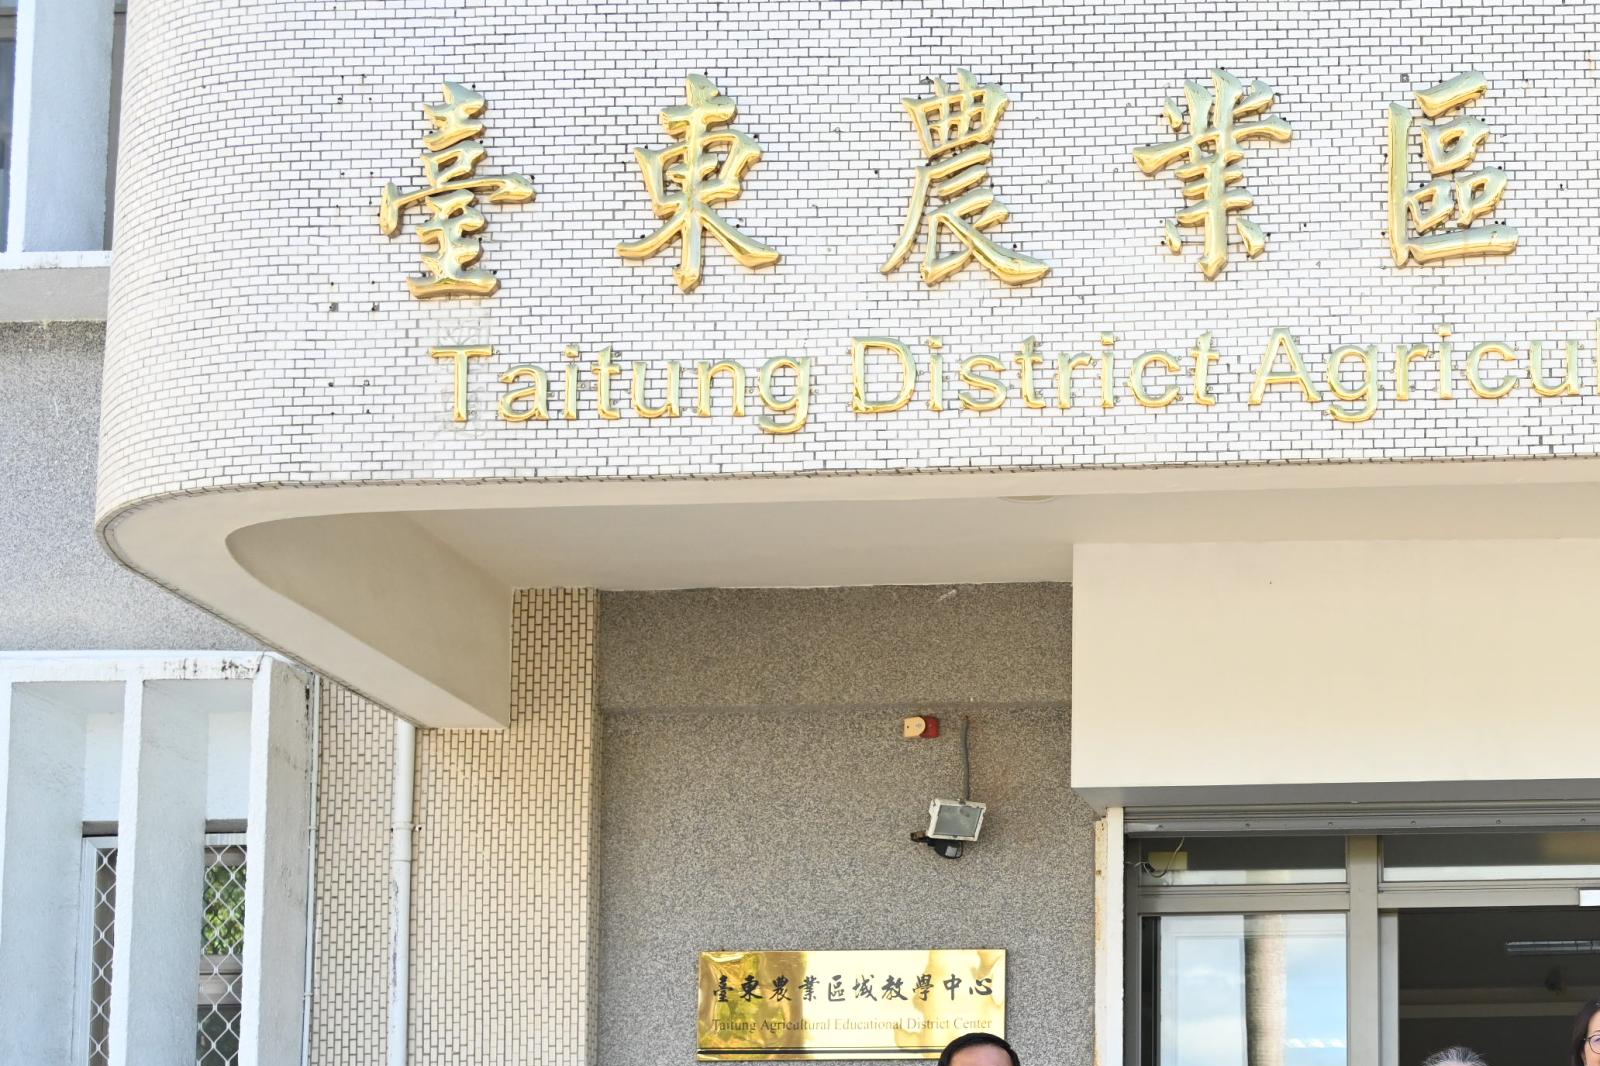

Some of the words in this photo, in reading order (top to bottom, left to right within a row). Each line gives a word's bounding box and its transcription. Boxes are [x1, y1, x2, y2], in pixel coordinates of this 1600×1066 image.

[429, 342, 812, 435] Taitung
[850, 329, 1217, 416] District
[713, 974, 993, 1002] 臺東農業區域教學中心
[712, 1019, 757, 1033] Taitung
[760, 1019, 831, 1033] Agricultural
[834, 1018, 902, 1030] Educational
[906, 1018, 950, 1030] District
[953, 1018, 992, 1030] Center
